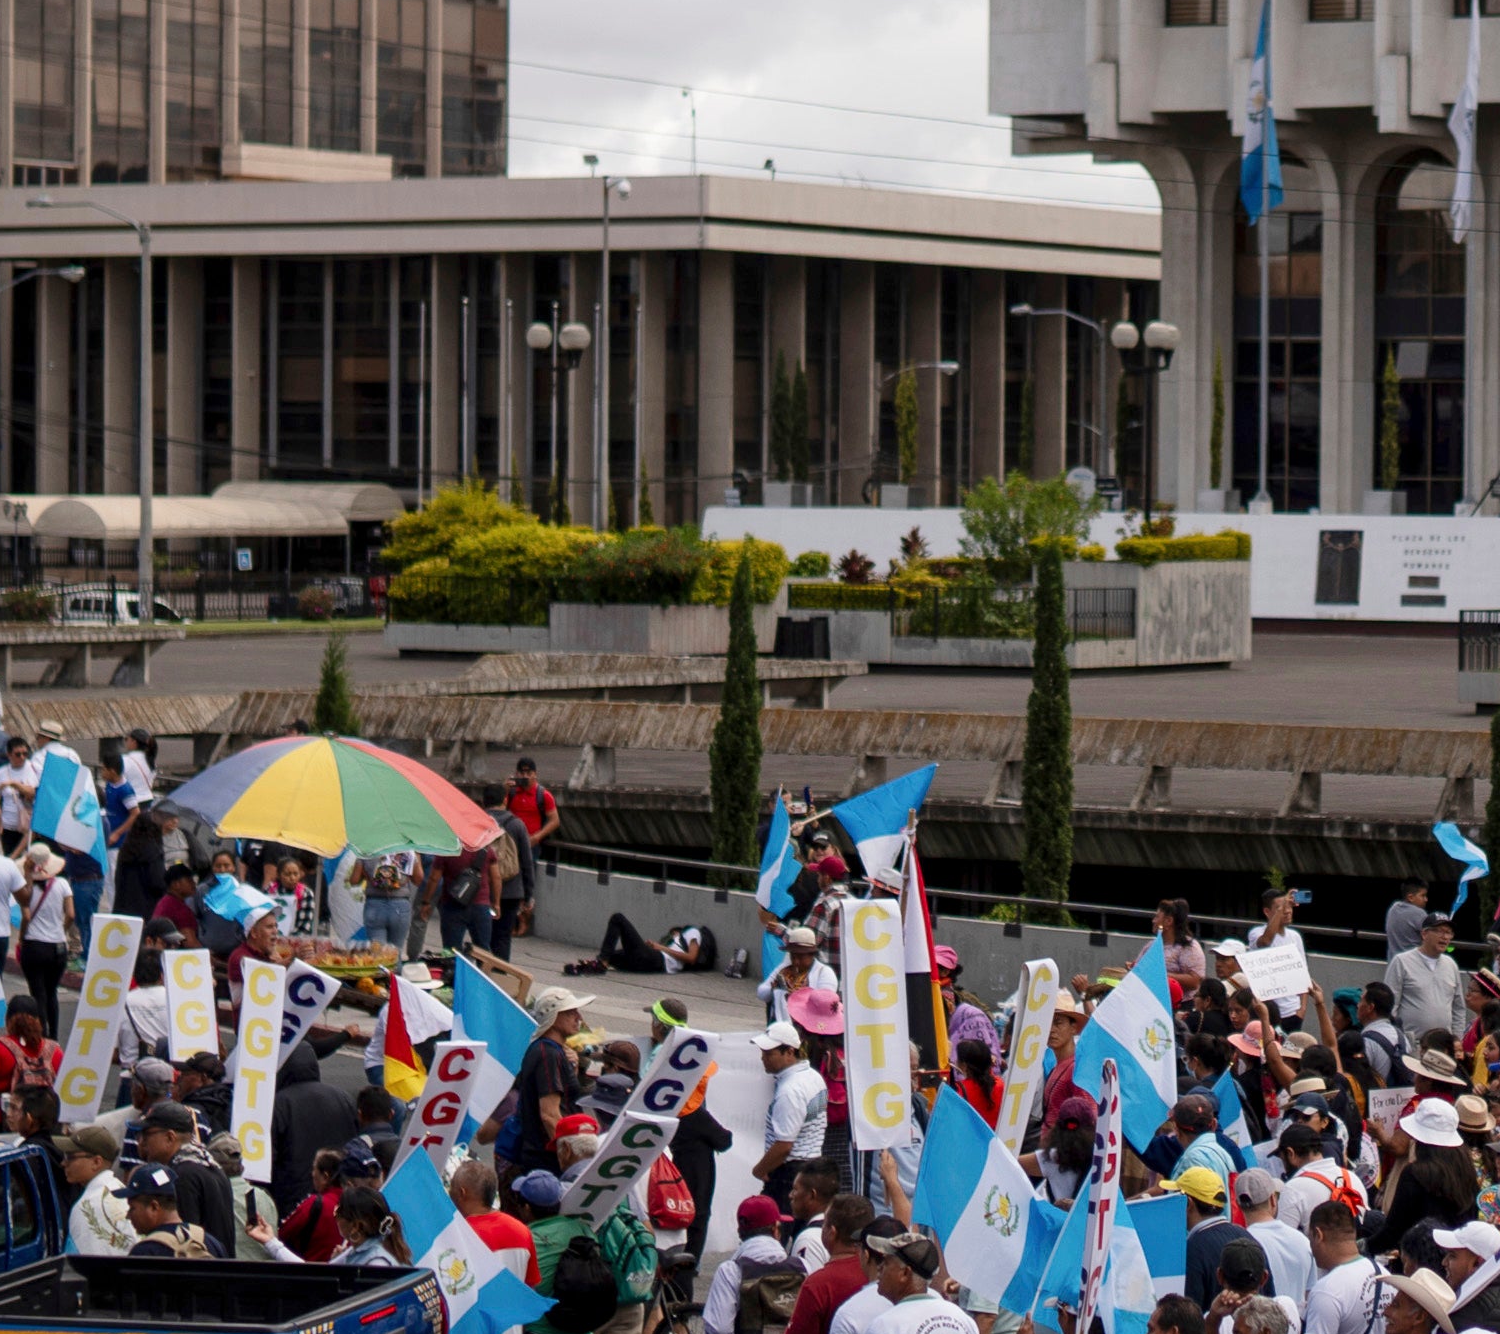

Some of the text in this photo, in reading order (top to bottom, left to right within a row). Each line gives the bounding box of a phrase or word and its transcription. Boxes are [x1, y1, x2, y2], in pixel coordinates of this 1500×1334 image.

[59, 920, 133, 1107] CGTG
[238, 966, 278, 1161] CGTG
[409, 1047, 476, 1153] CGT
[643, 1035, 709, 1112] CG
[852, 905, 905, 1129] CGTG
[1003, 966, 1053, 1155] CGT
